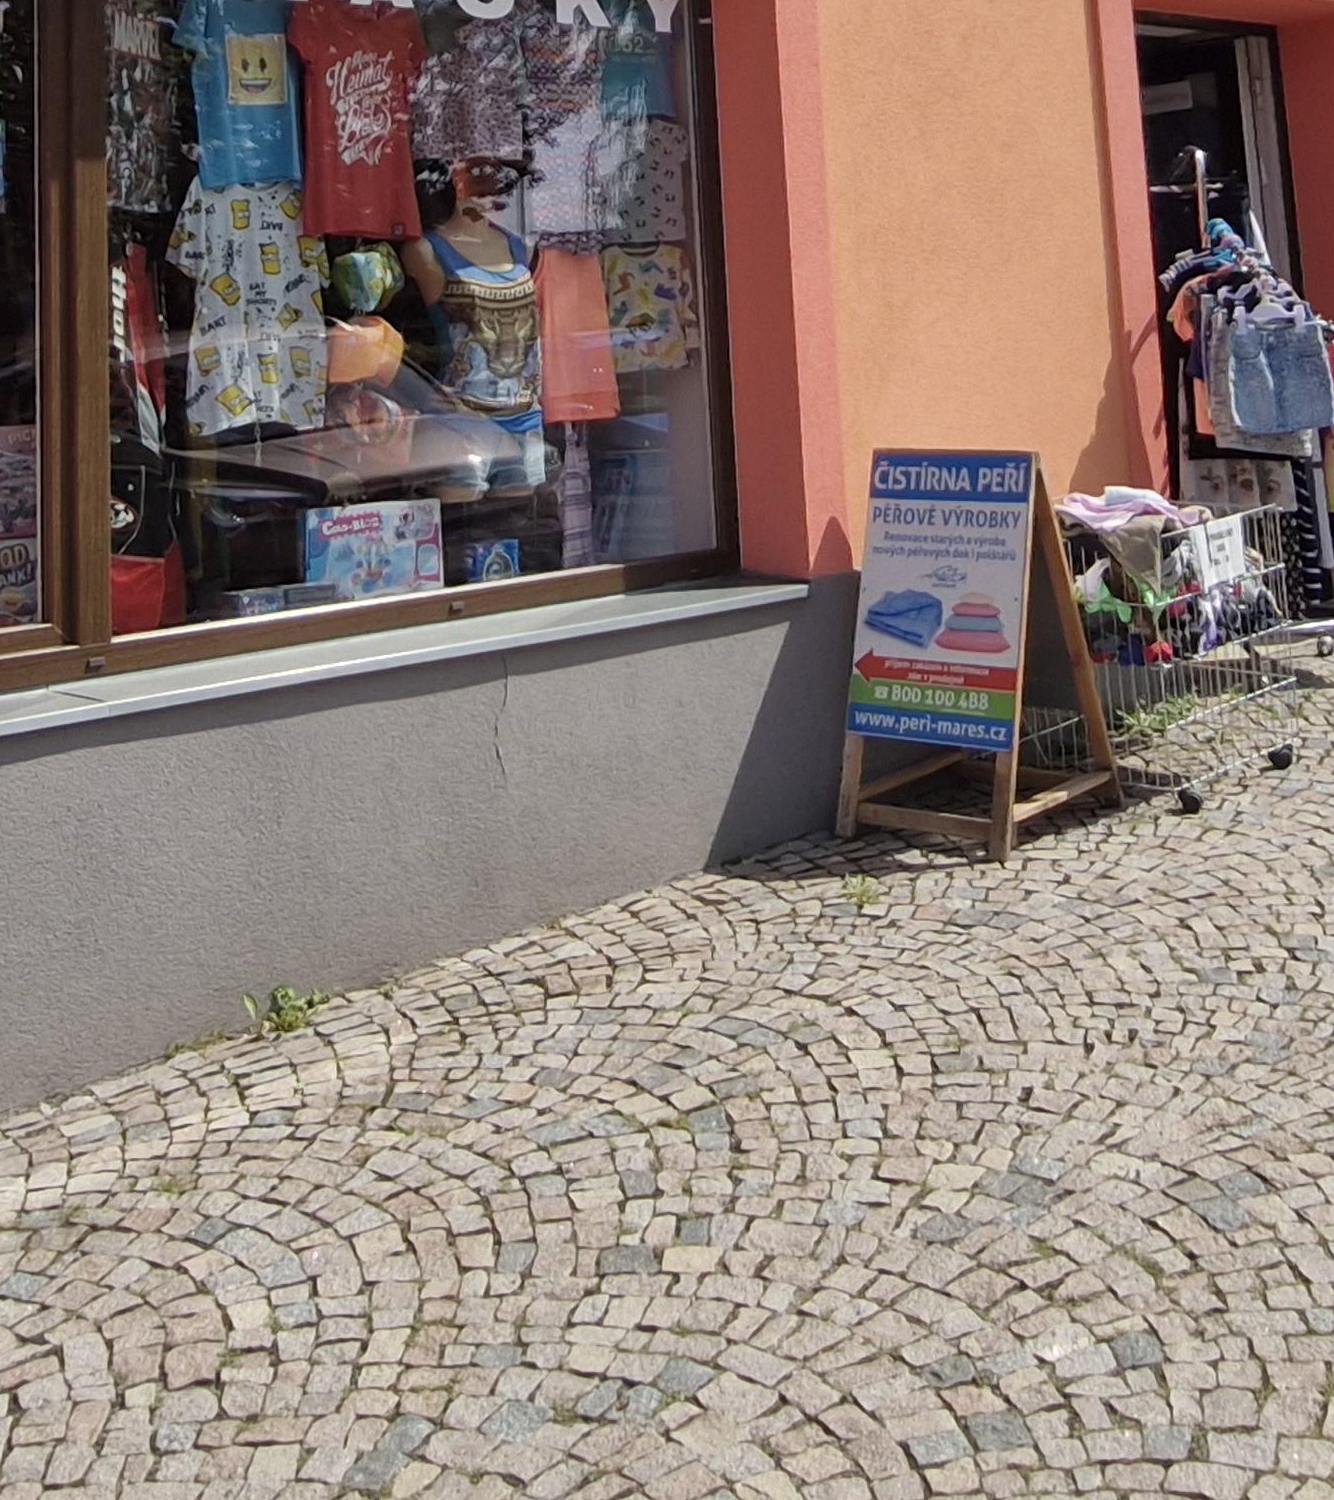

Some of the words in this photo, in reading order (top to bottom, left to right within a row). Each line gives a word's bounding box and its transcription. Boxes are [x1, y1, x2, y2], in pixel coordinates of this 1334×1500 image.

[874, 461, 971, 491] ČISTÍRNA
[977, 462, 1028, 493] PEŘÍ
[872, 503, 937, 526] PÉŘOVÉ
[941, 505, 1022, 529] VÝROBKY
[892, 685, 922, 703] 800
[924, 689, 955, 707] 100
